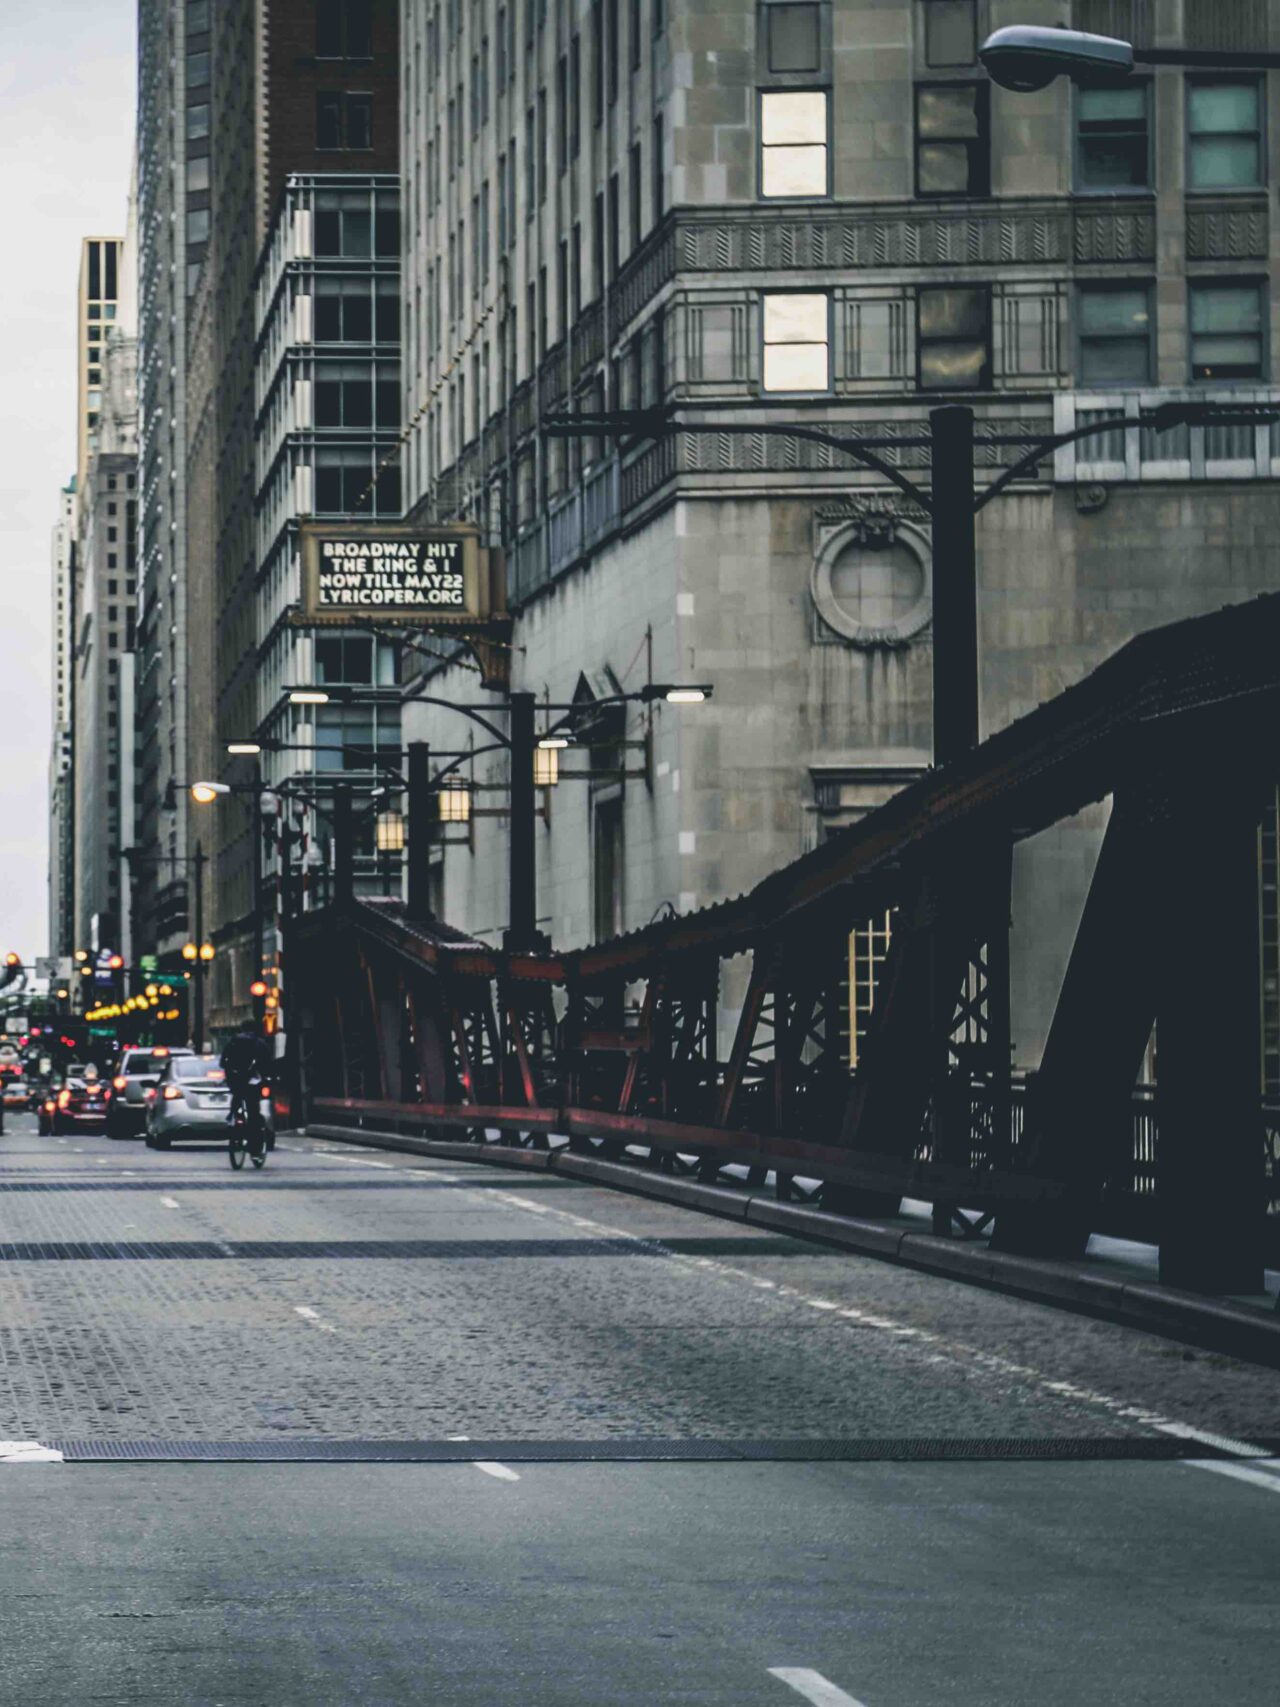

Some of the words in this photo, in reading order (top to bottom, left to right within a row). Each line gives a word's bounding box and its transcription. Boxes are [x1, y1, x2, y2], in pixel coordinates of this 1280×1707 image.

[323, 543, 420, 557] BROADWAY
[428, 543, 458, 557] HIT
[331, 559, 367, 573] THE
[373, 559, 417, 573] KING
[423, 559, 437, 573] &
[444, 559, 450, 573] I
[320, 574, 361, 588] NOW
[363, 574, 402, 588] TILL
[320, 589, 463, 604] LYRICOPERA.ORG
